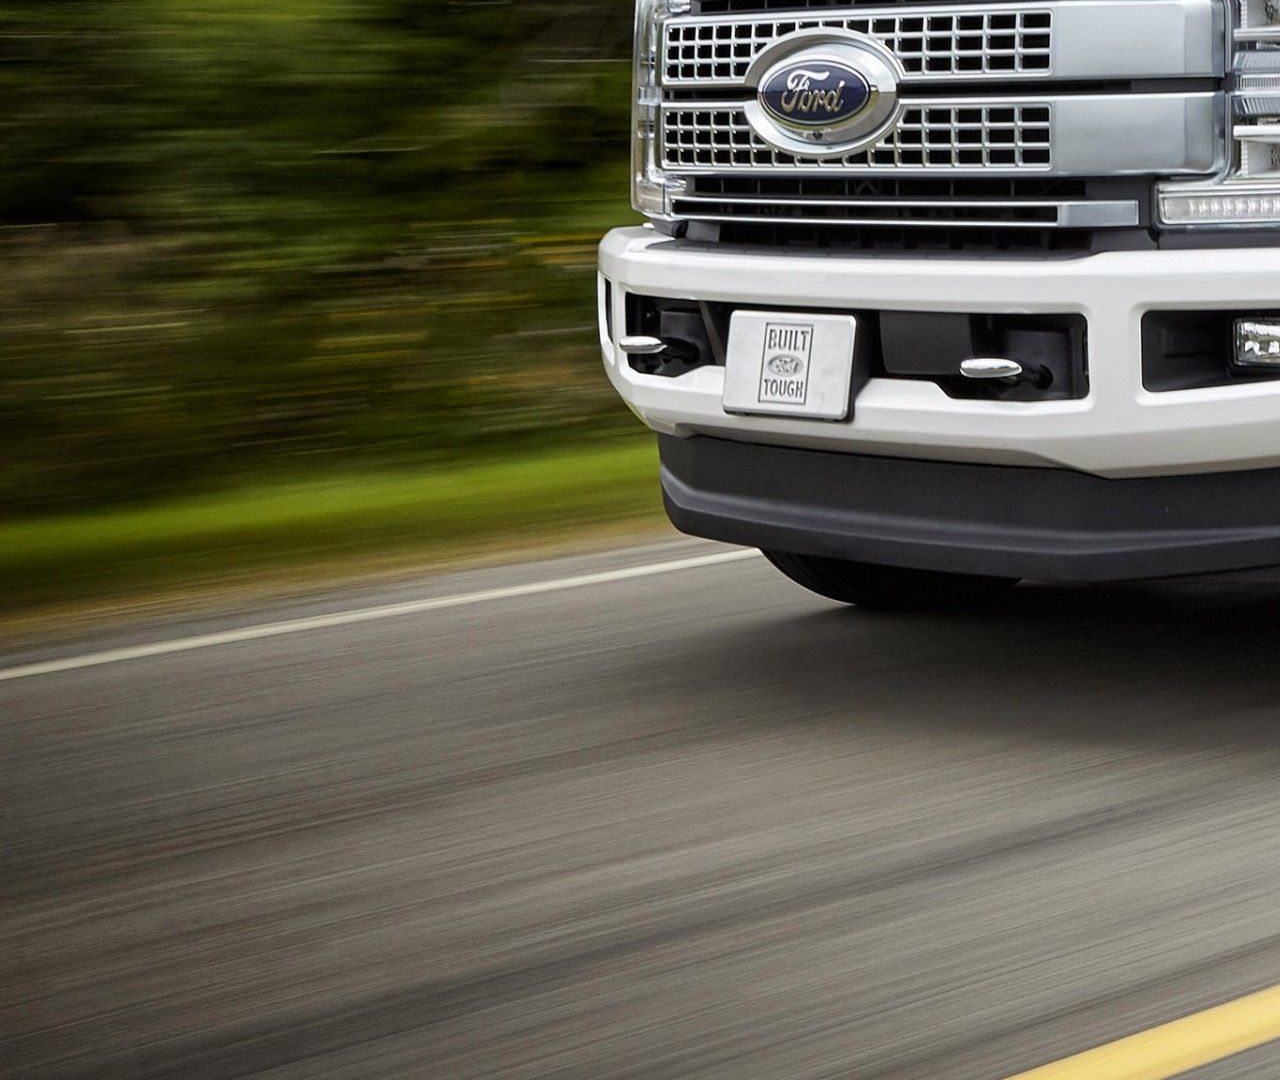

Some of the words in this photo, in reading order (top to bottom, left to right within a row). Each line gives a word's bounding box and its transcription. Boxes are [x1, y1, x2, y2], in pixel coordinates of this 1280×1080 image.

[780, 69, 845, 113] Ford
[767, 328, 810, 352] BUILT
[763, 378, 804, 399] TOUGH
